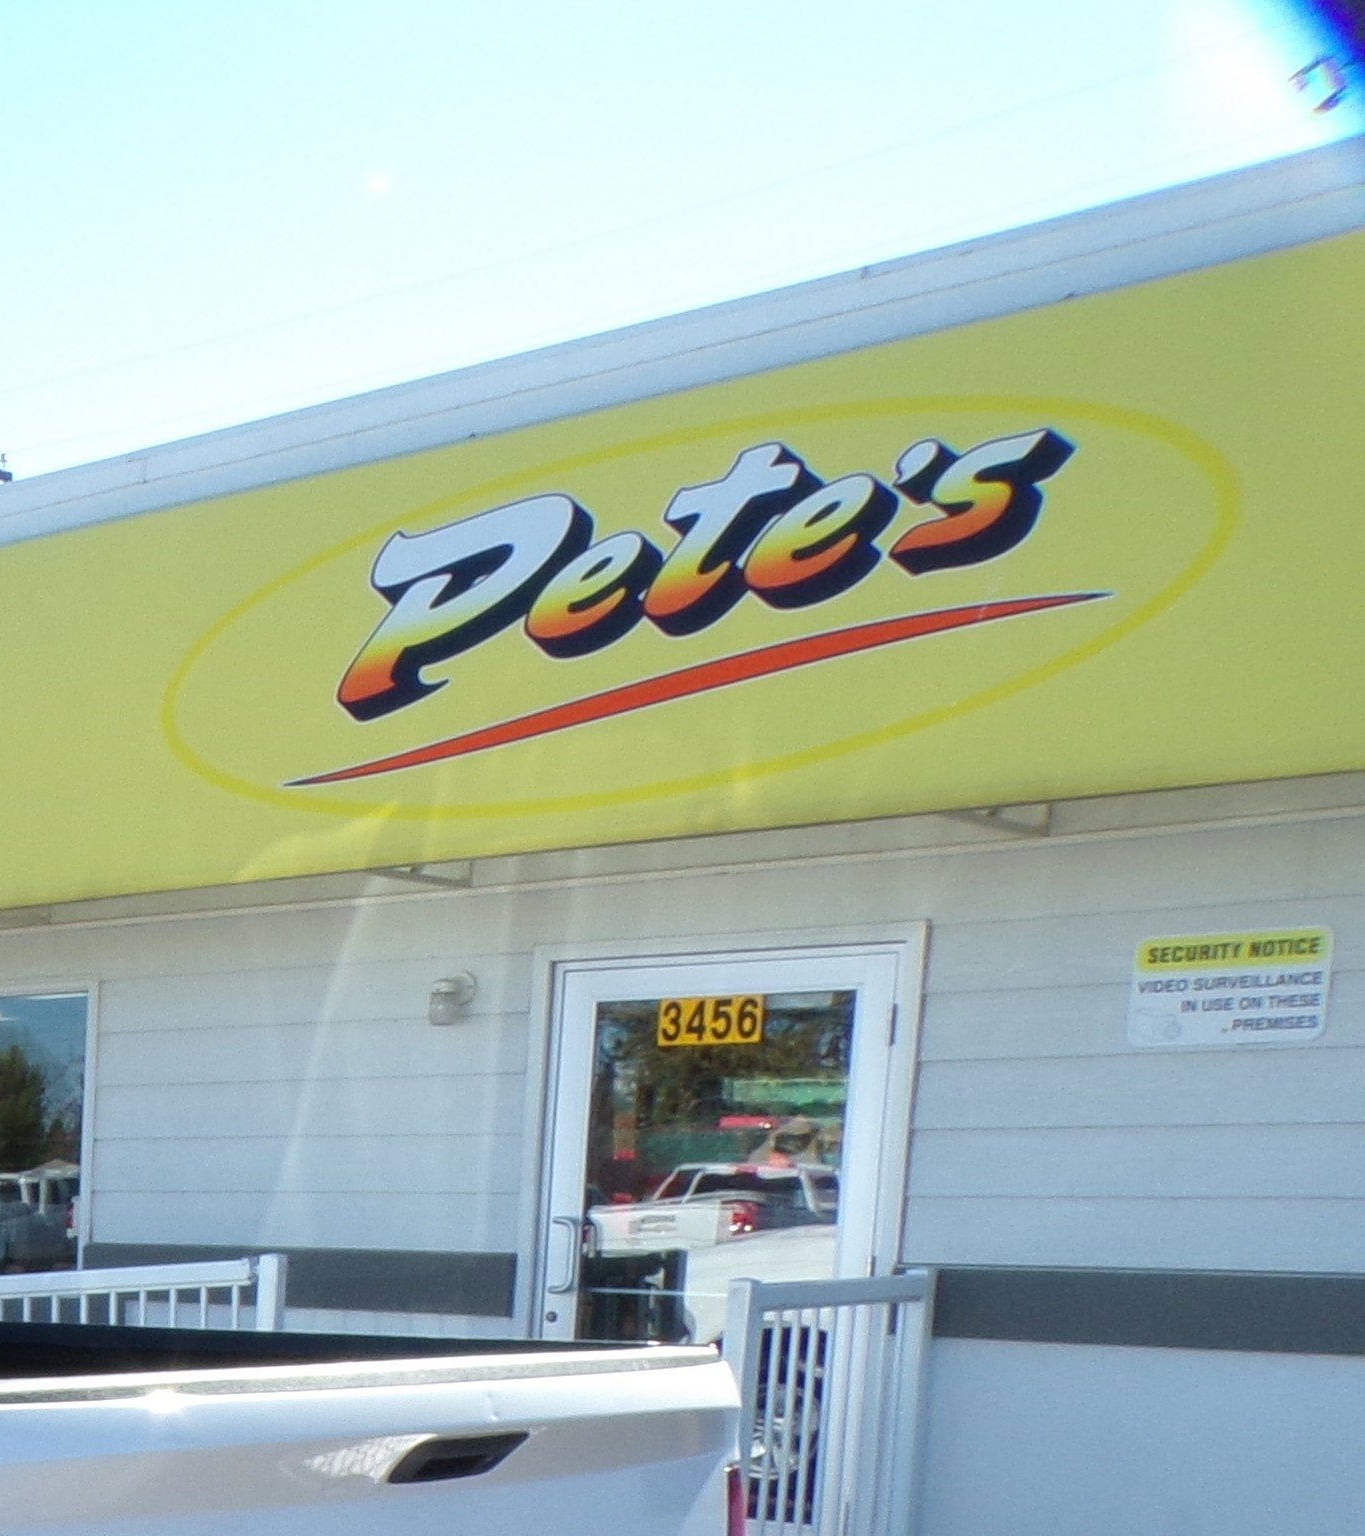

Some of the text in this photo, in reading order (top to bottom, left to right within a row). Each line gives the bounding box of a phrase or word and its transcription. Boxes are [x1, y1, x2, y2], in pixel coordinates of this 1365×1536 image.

[336, 428, 1077, 721] Pete's
[1147, 936, 1322, 964] SECURITY NOTICE
[1137, 970, 1323, 994] VIDEO SURVEILLANCE
[1180, 992, 1321, 1012] IN USE ON THESE
[661, 998, 760, 1041] 3456
[1231, 1014, 1319, 1031] PREMISES
